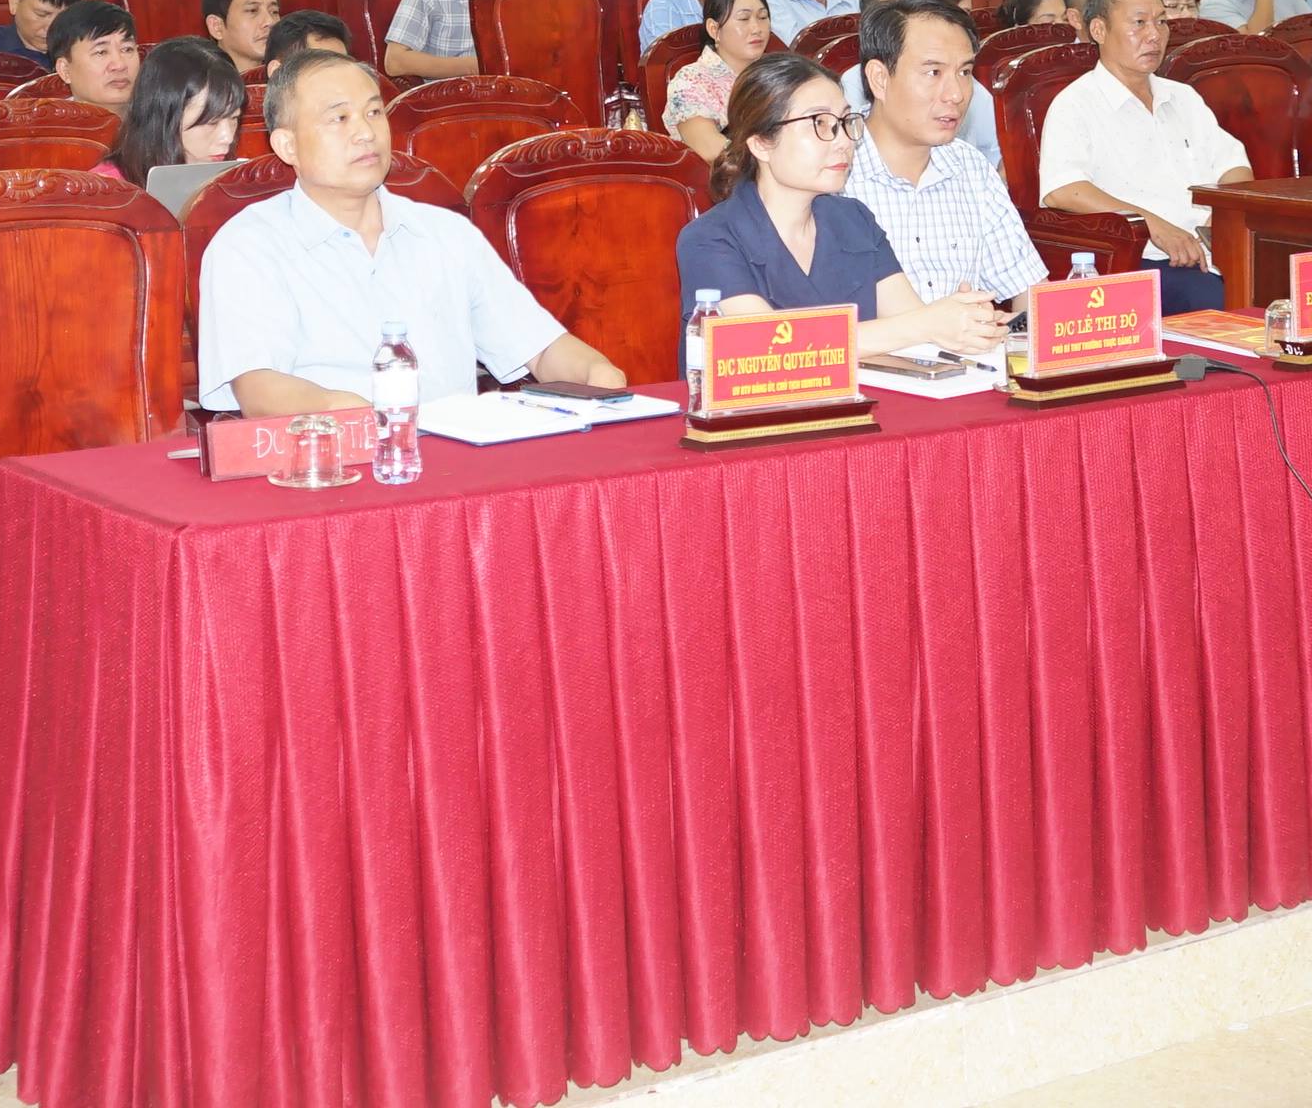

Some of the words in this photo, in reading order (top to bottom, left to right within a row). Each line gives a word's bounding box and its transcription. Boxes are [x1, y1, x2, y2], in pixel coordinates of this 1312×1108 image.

[1054, 320, 1075, 338] Đ/C
[1077, 313, 1093, 335] LÊ
[1095, 315, 1117, 334] THỊ
[1119, 308, 1138, 332] ĐỘ
[717, 358, 736, 379] Đ/C
[737, 346, 782, 375] NGUYỄN
[783, 342, 819, 371] QUYẾT
[820, 345, 845, 366] TÍNH
